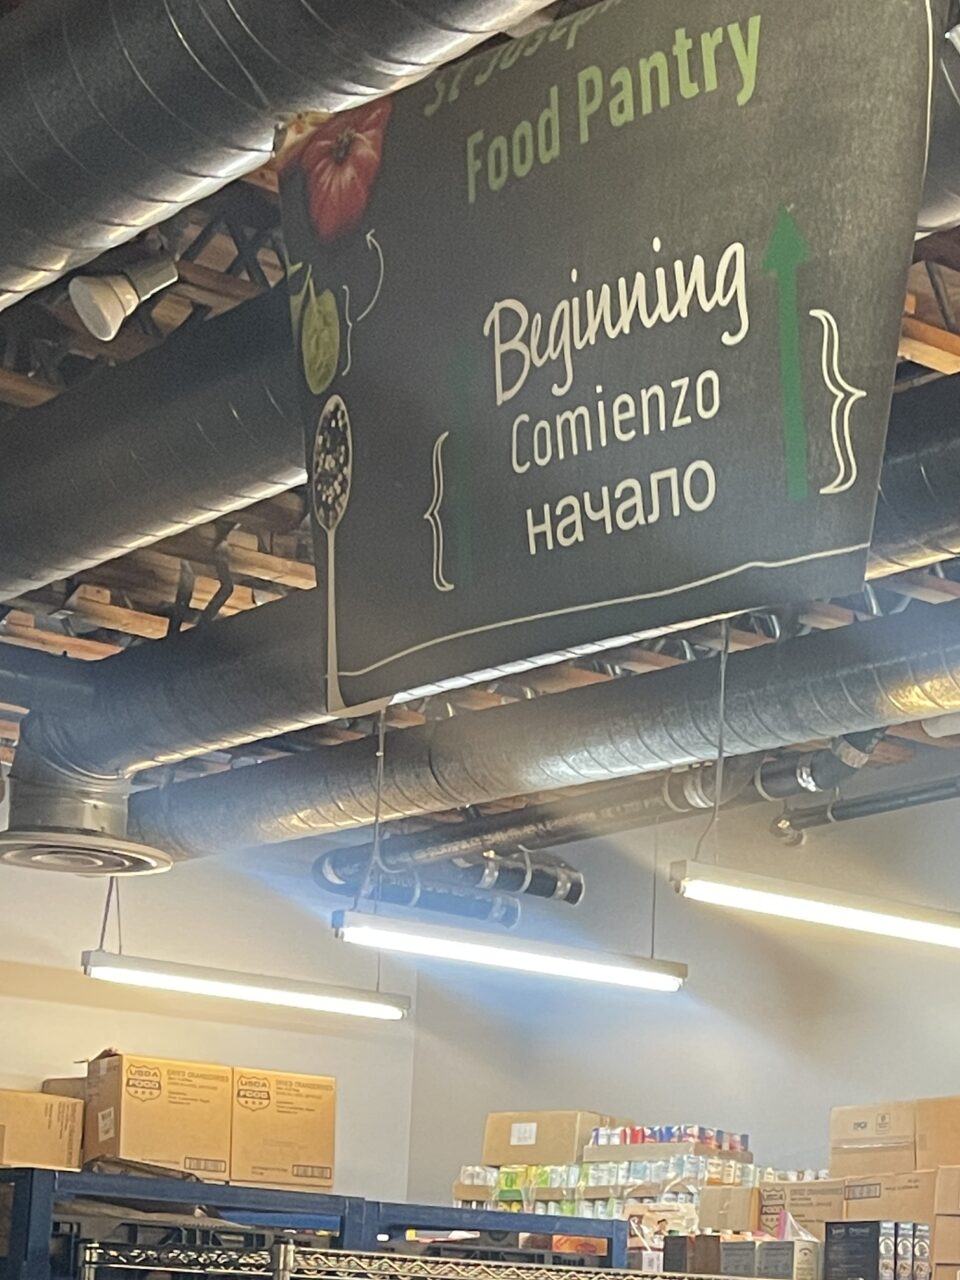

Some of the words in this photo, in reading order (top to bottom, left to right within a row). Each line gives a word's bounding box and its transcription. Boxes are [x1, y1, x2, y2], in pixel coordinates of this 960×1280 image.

[466, 85, 560, 204] Food
[577, 15, 761, 144] Pantry
[483, 236, 749, 406] Beginning
[511, 369, 721, 474] Comienzo
[526, 459, 716, 555] начало
[128, 1080, 160, 1089] FOOD
[129, 1069, 159, 1078] USDA
[239, 1090, 269, 1099] FOOD
[240, 1080, 268, 1088] USDA
